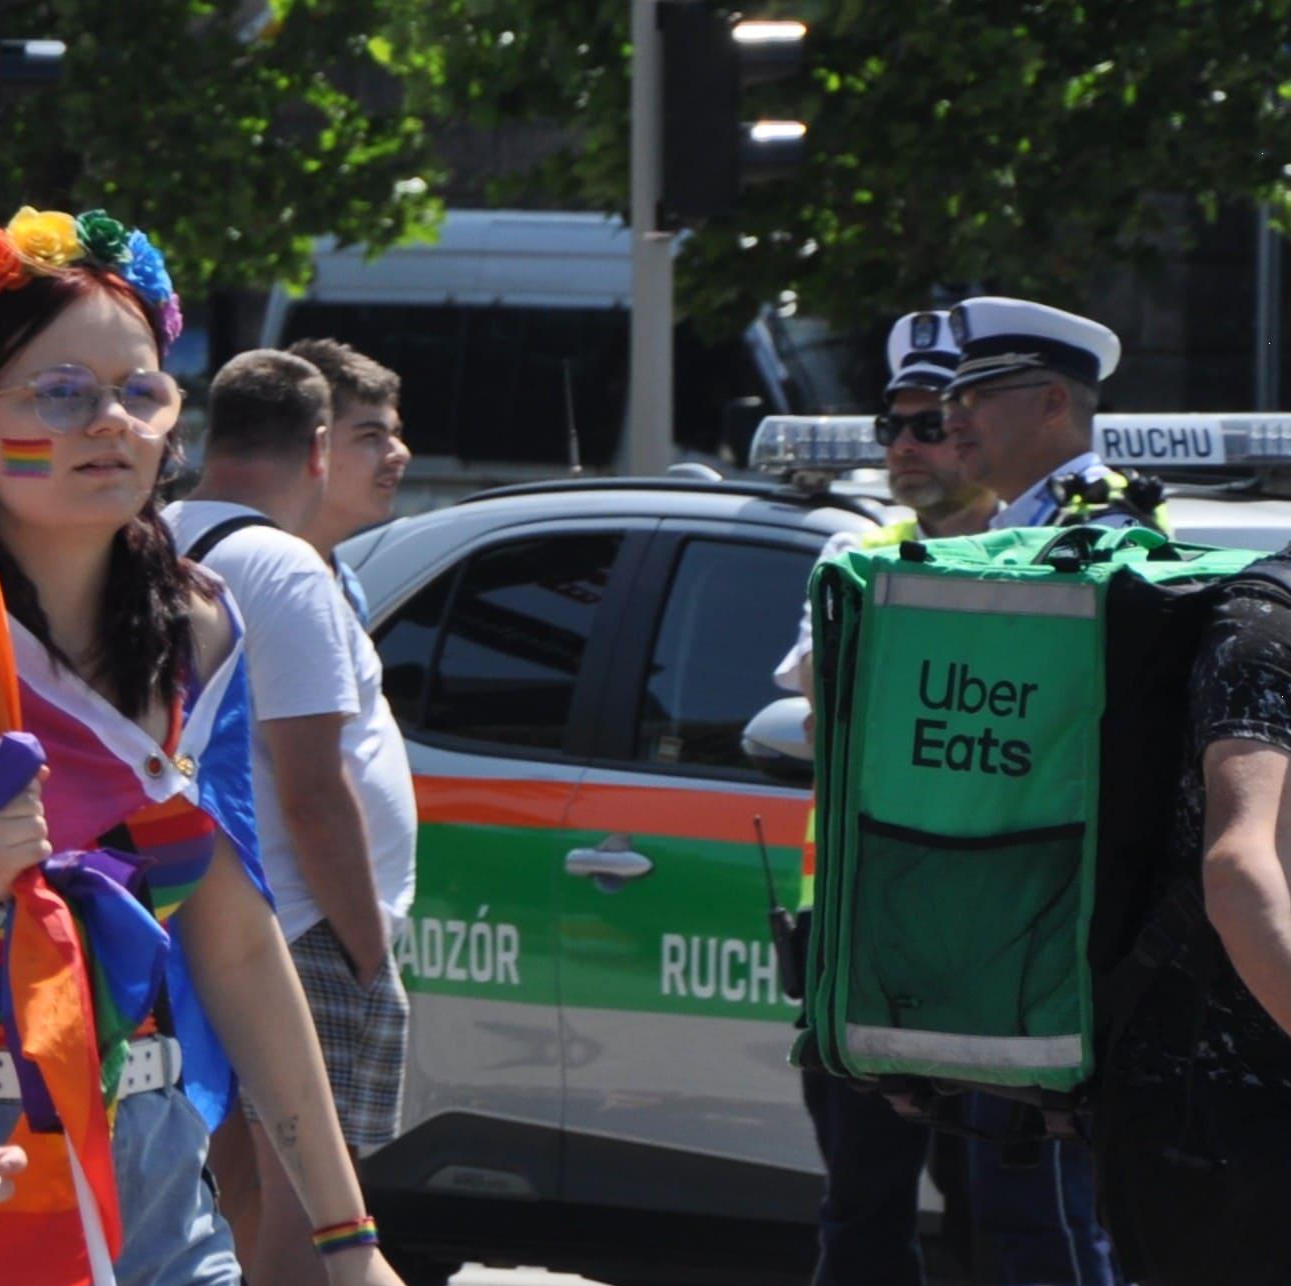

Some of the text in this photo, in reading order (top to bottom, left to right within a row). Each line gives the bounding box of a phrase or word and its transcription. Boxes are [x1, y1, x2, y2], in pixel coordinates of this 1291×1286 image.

[1102, 427, 1212, 458] RUCHU
[919, 659, 1039, 719] Uber
[911, 717, 1033, 777] Eats
[392, 904, 804, 1007] ADZÓR RUCH
